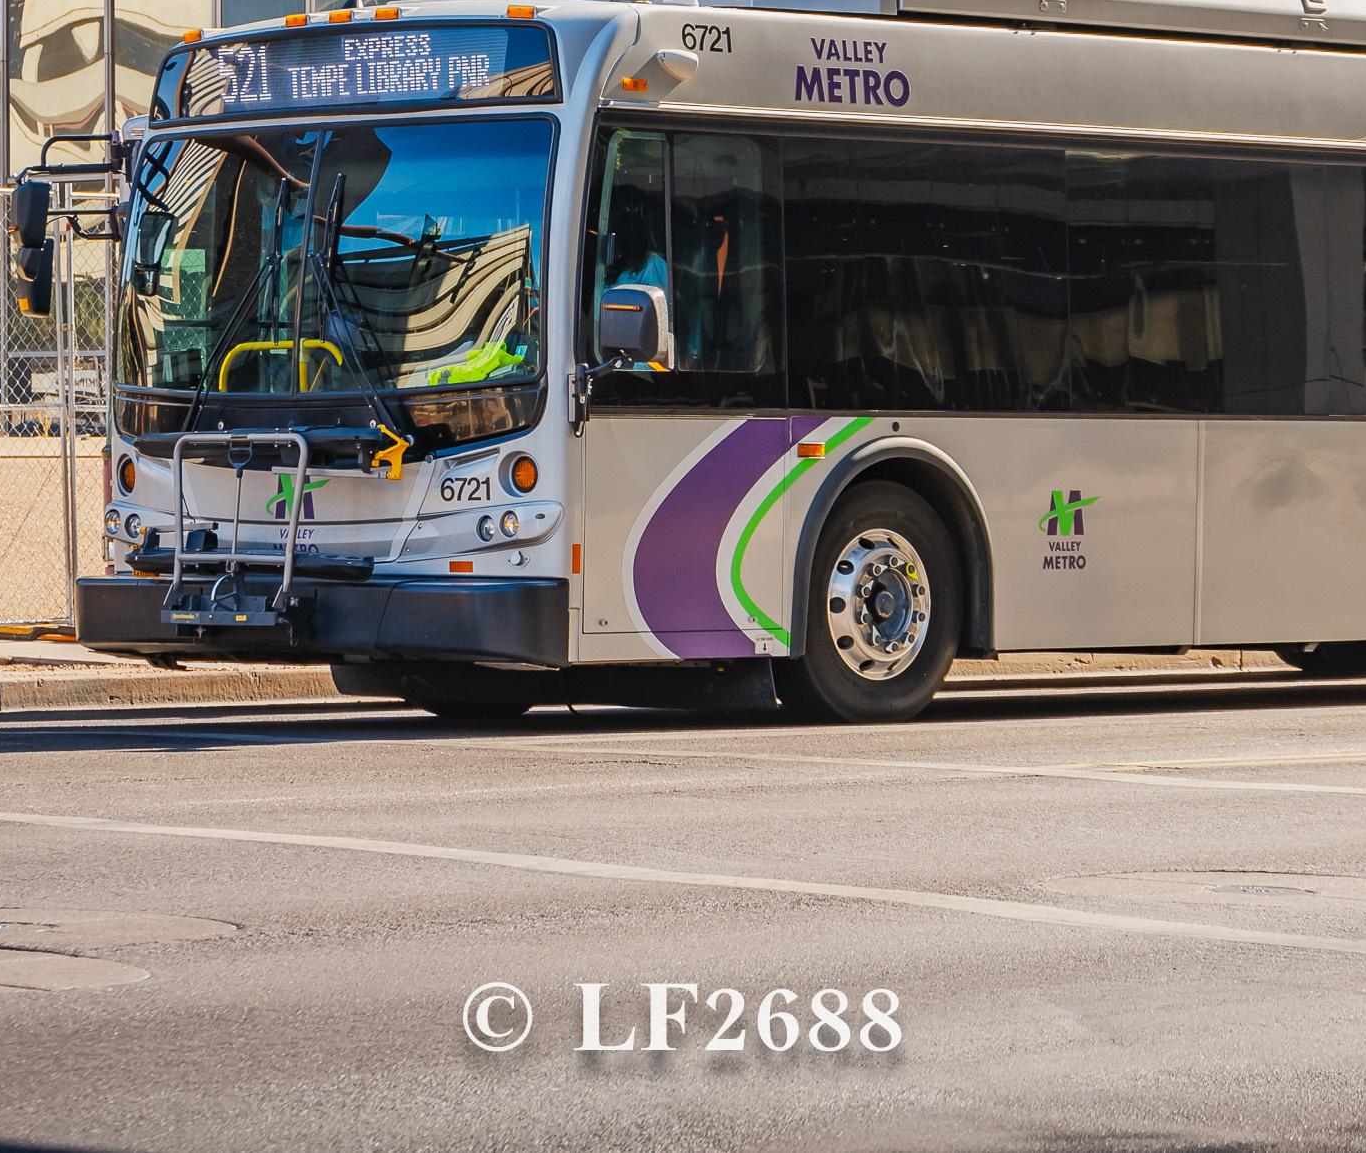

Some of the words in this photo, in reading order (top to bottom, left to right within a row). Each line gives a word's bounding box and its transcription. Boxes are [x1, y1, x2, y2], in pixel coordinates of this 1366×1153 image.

[343, 33, 431, 61] EXPRESS
[681, 23, 732, 54] 6721
[810, 38, 887, 64] VALLEY
[218, 45, 272, 103] 521
[288, 64, 350, 99] TEMPE
[356, 56, 441, 94] LIBRARY
[448, 54, 490, 88] PNR
[794, 66, 910, 107] METRO
[440, 477, 491, 501] 6721
[280, 529, 315, 539] VLEY
[1048, 541, 1082, 552] VALLEY
[273, 543, 320, 553] MRO
[1043, 555, 1087, 570] METRO
